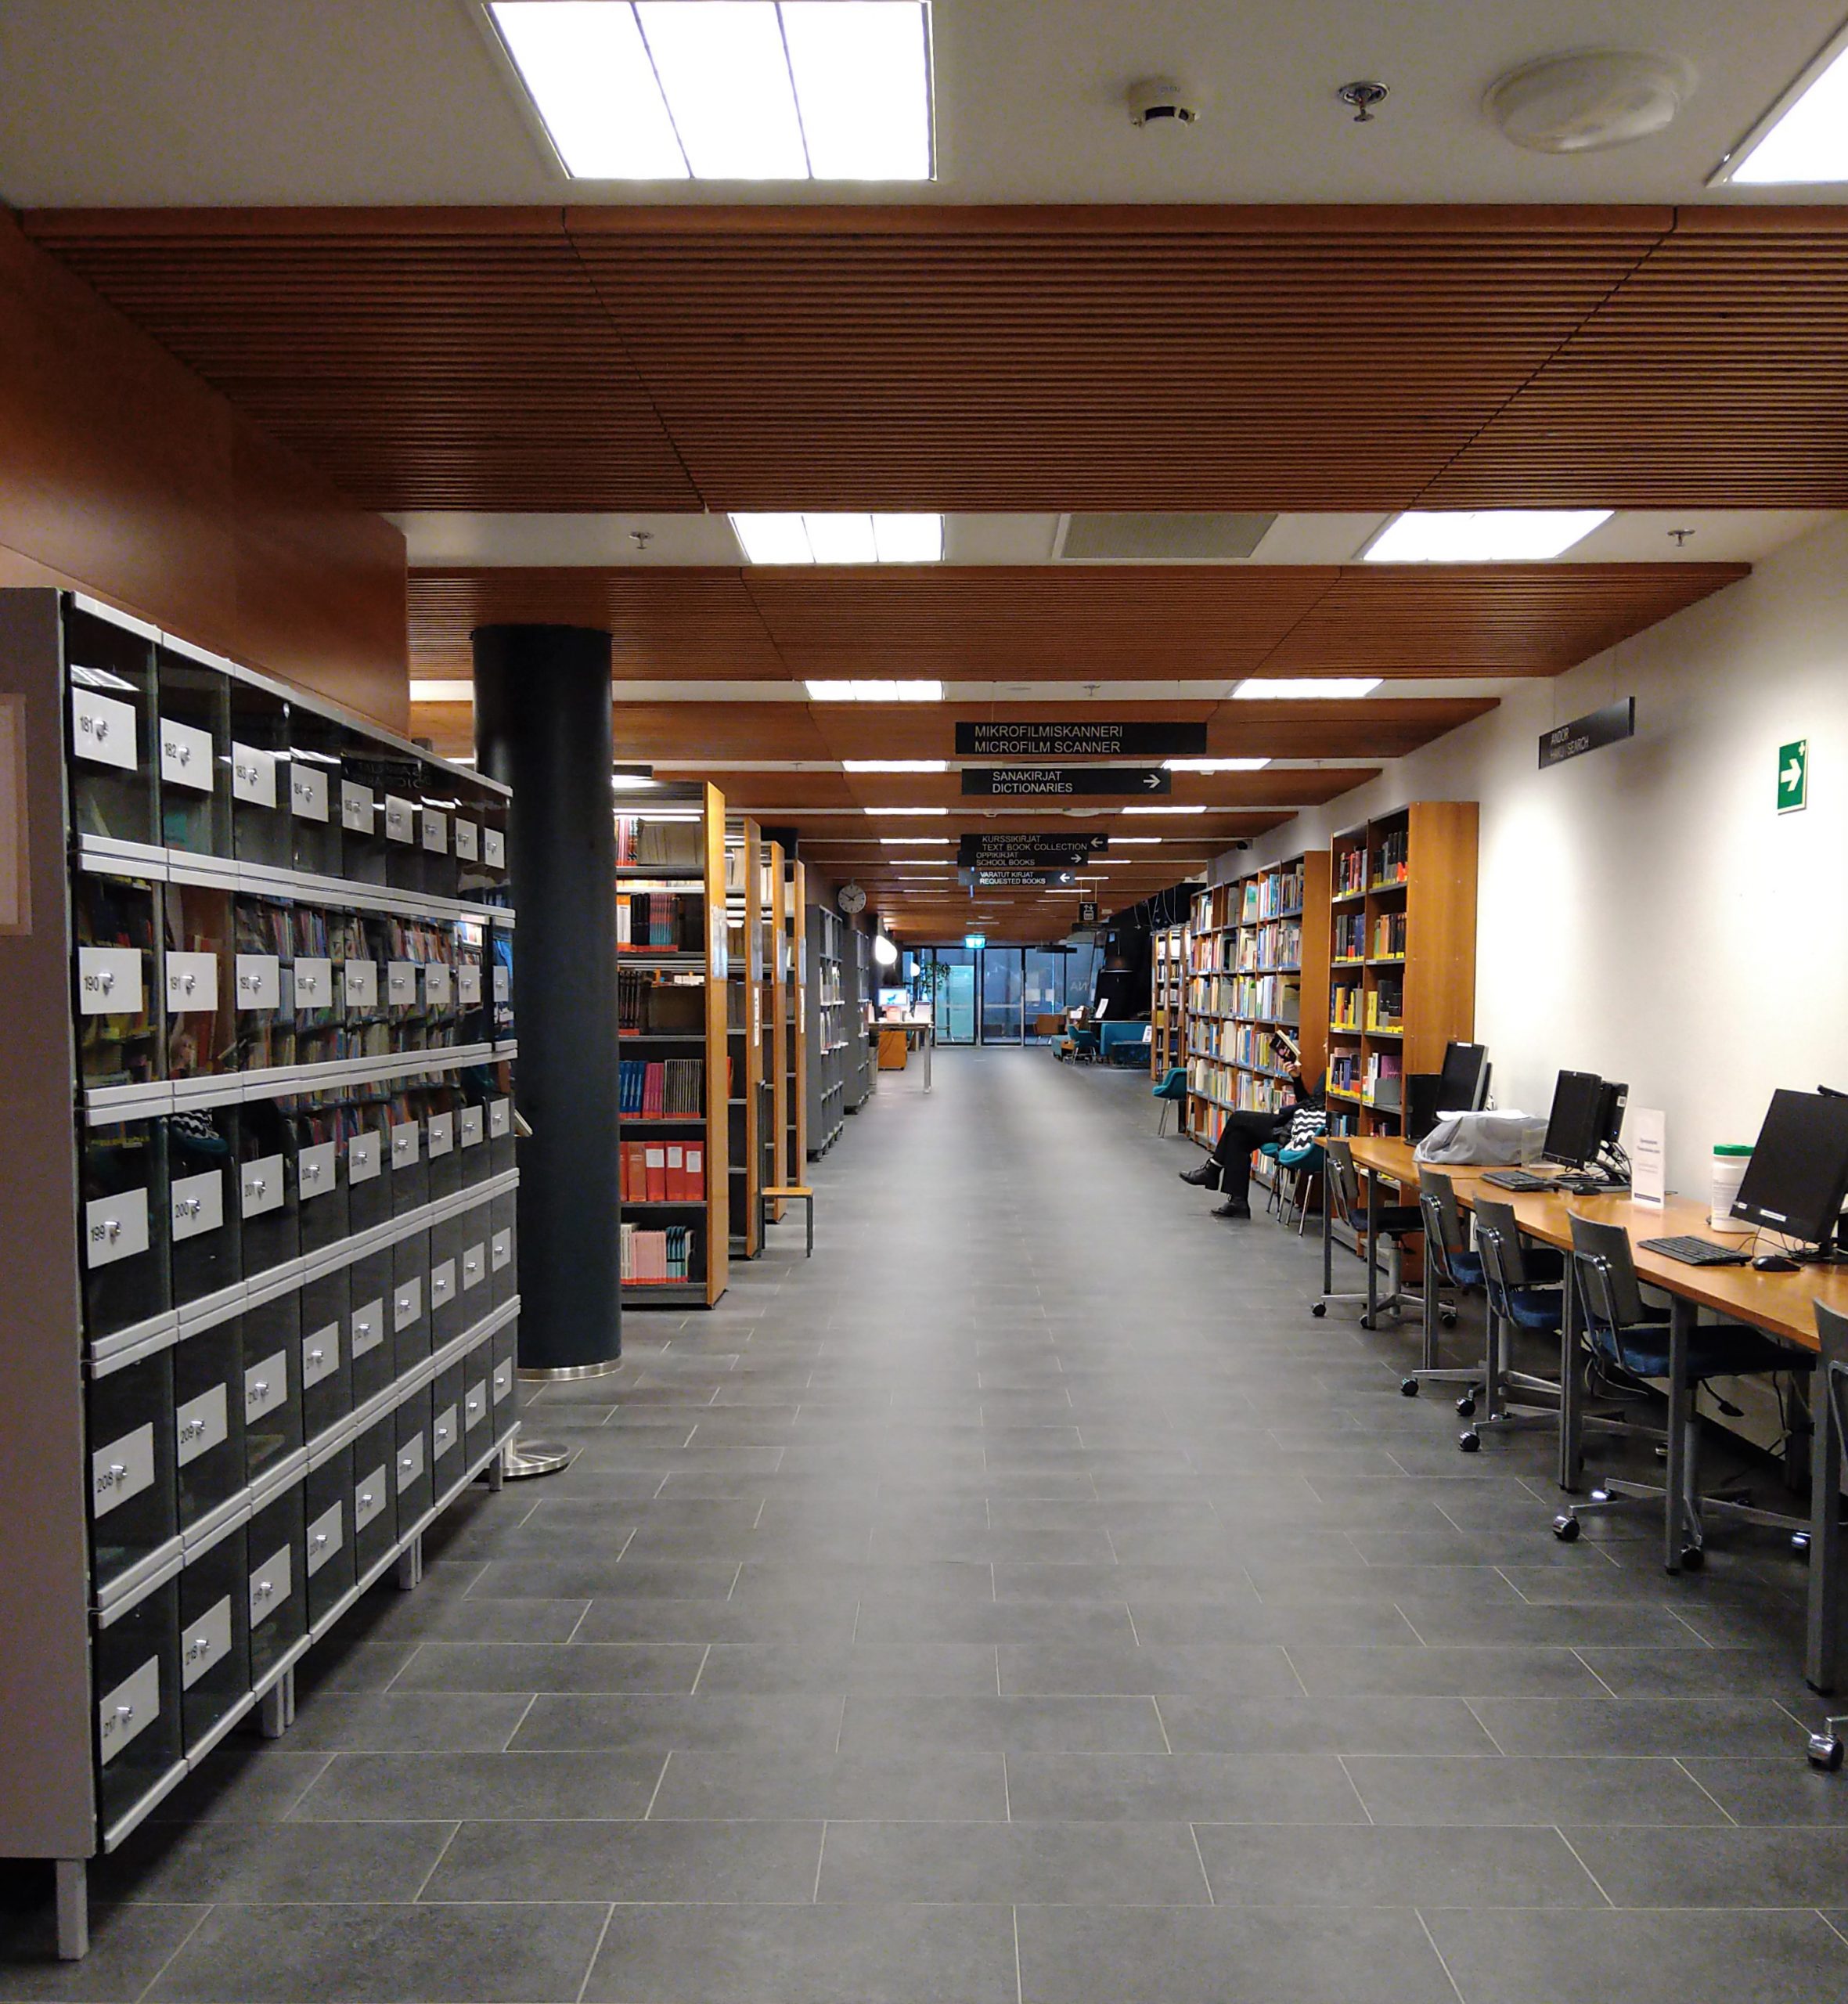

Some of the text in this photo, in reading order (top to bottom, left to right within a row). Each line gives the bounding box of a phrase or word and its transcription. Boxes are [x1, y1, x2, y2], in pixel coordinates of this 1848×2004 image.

[80, 716, 94, 733] 181
[974, 726, 1123, 737] MIKROFILMISKANNERI
[164, 742, 177, 758] 182
[974, 741, 1121, 753] MICROFILM SCANNER
[1567, 735, 1590, 755] SEARCH
[992, 771, 1062, 781] SANAKIRJAT
[992, 783, 1073, 793] DICTIONARIES
[84, 975, 99, 992] 190
[175, 1202, 189, 1218] 200
[91, 1224, 106, 1242] 199
[180, 1426, 194, 1444] 209
[96, 1472, 113, 1493] 208
